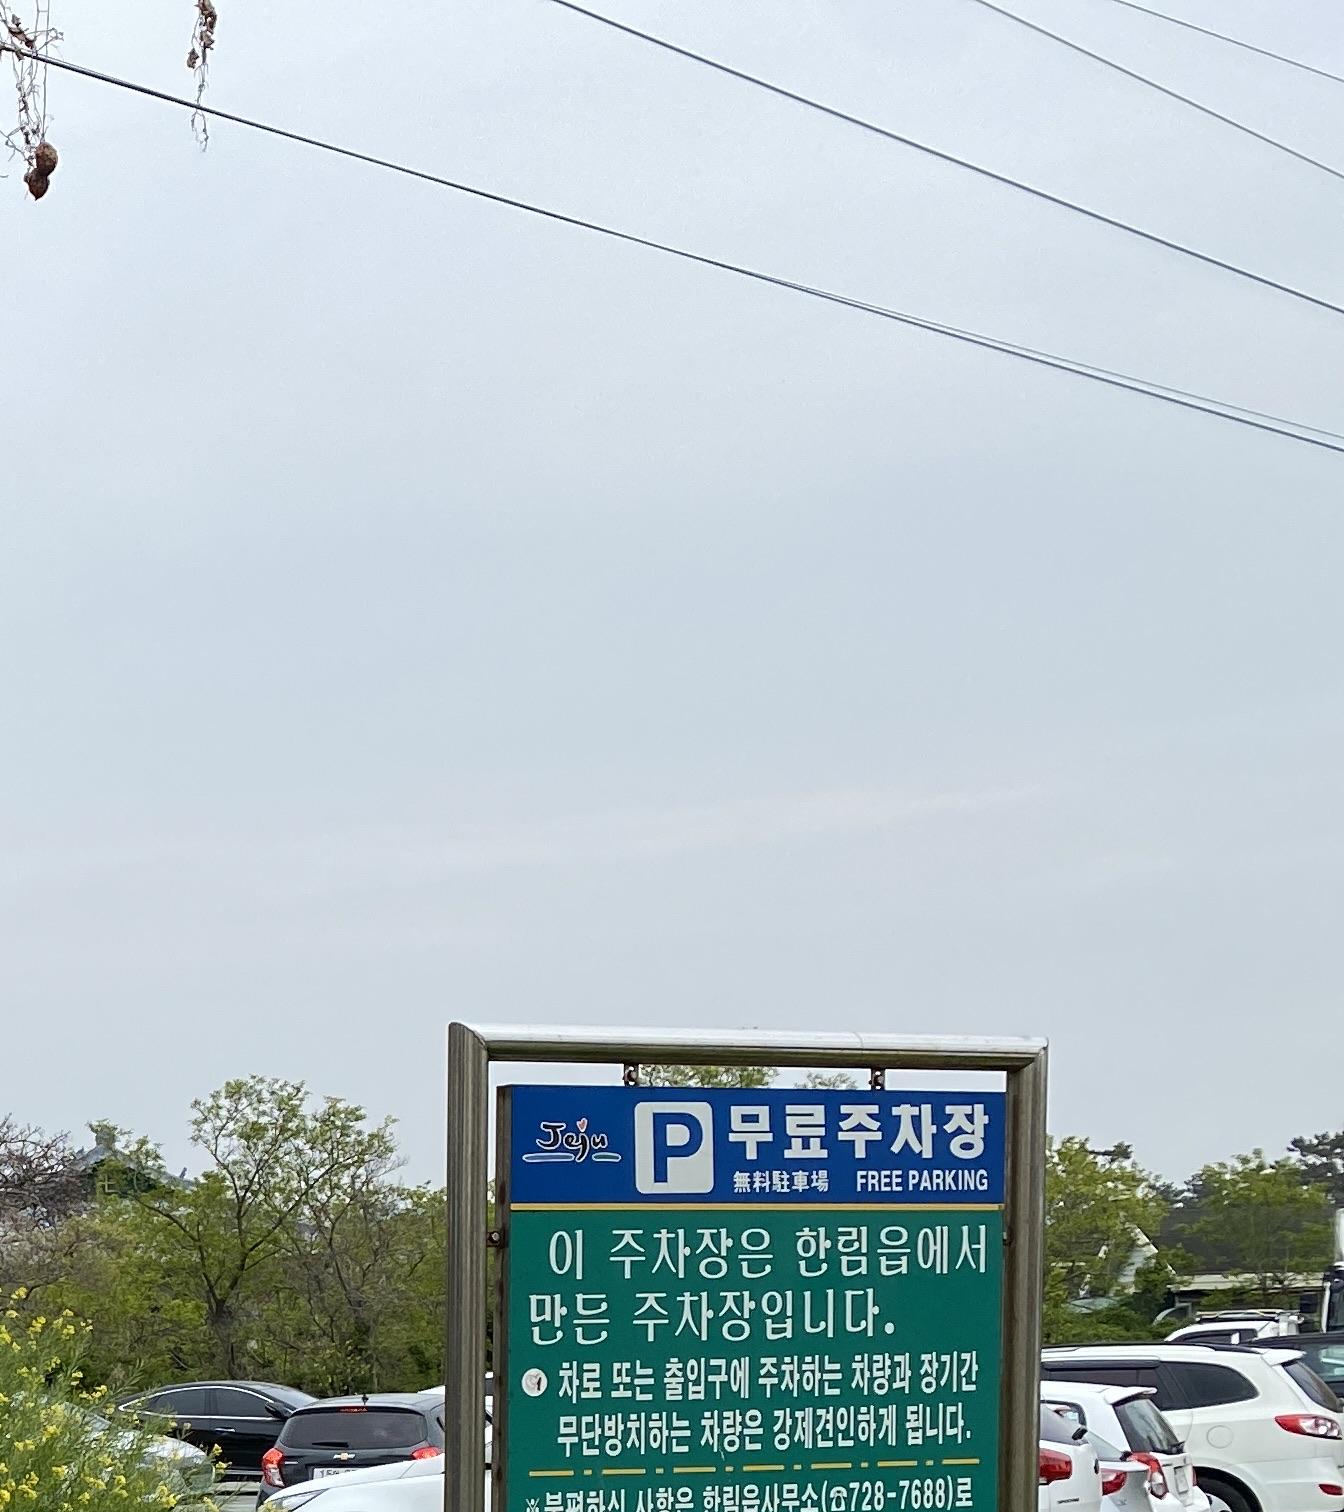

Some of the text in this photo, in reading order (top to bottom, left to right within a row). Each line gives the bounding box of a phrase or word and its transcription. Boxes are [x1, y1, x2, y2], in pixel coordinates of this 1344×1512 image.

[536, 1117, 609, 1162] Jeju
[653, 1112, 703, 1183] P
[728, 1103, 988, 1160] 무료주차장
[733, 1170, 829, 1193] 無料駐車場
[856, 1169, 988, 1192] FREE PARKING
[549, 1224, 987, 1280] 이 주차장은 한림읍에서
[528, 1287, 896, 1345] 만든 주차장입니다.
[558, 1360, 602, 1404] 차로
[611, 1359, 654, 1400] 또는
[664, 1356, 749, 1400] 출입구에
[758, 1354, 842, 1398] 주차하는
[851, 1352, 911, 1395] 차량과
[920, 1350, 978, 1393] 장기간
[557, 1402, 971, 1457] 무단방치하는 차량은 강제견인하게 됩니다.
